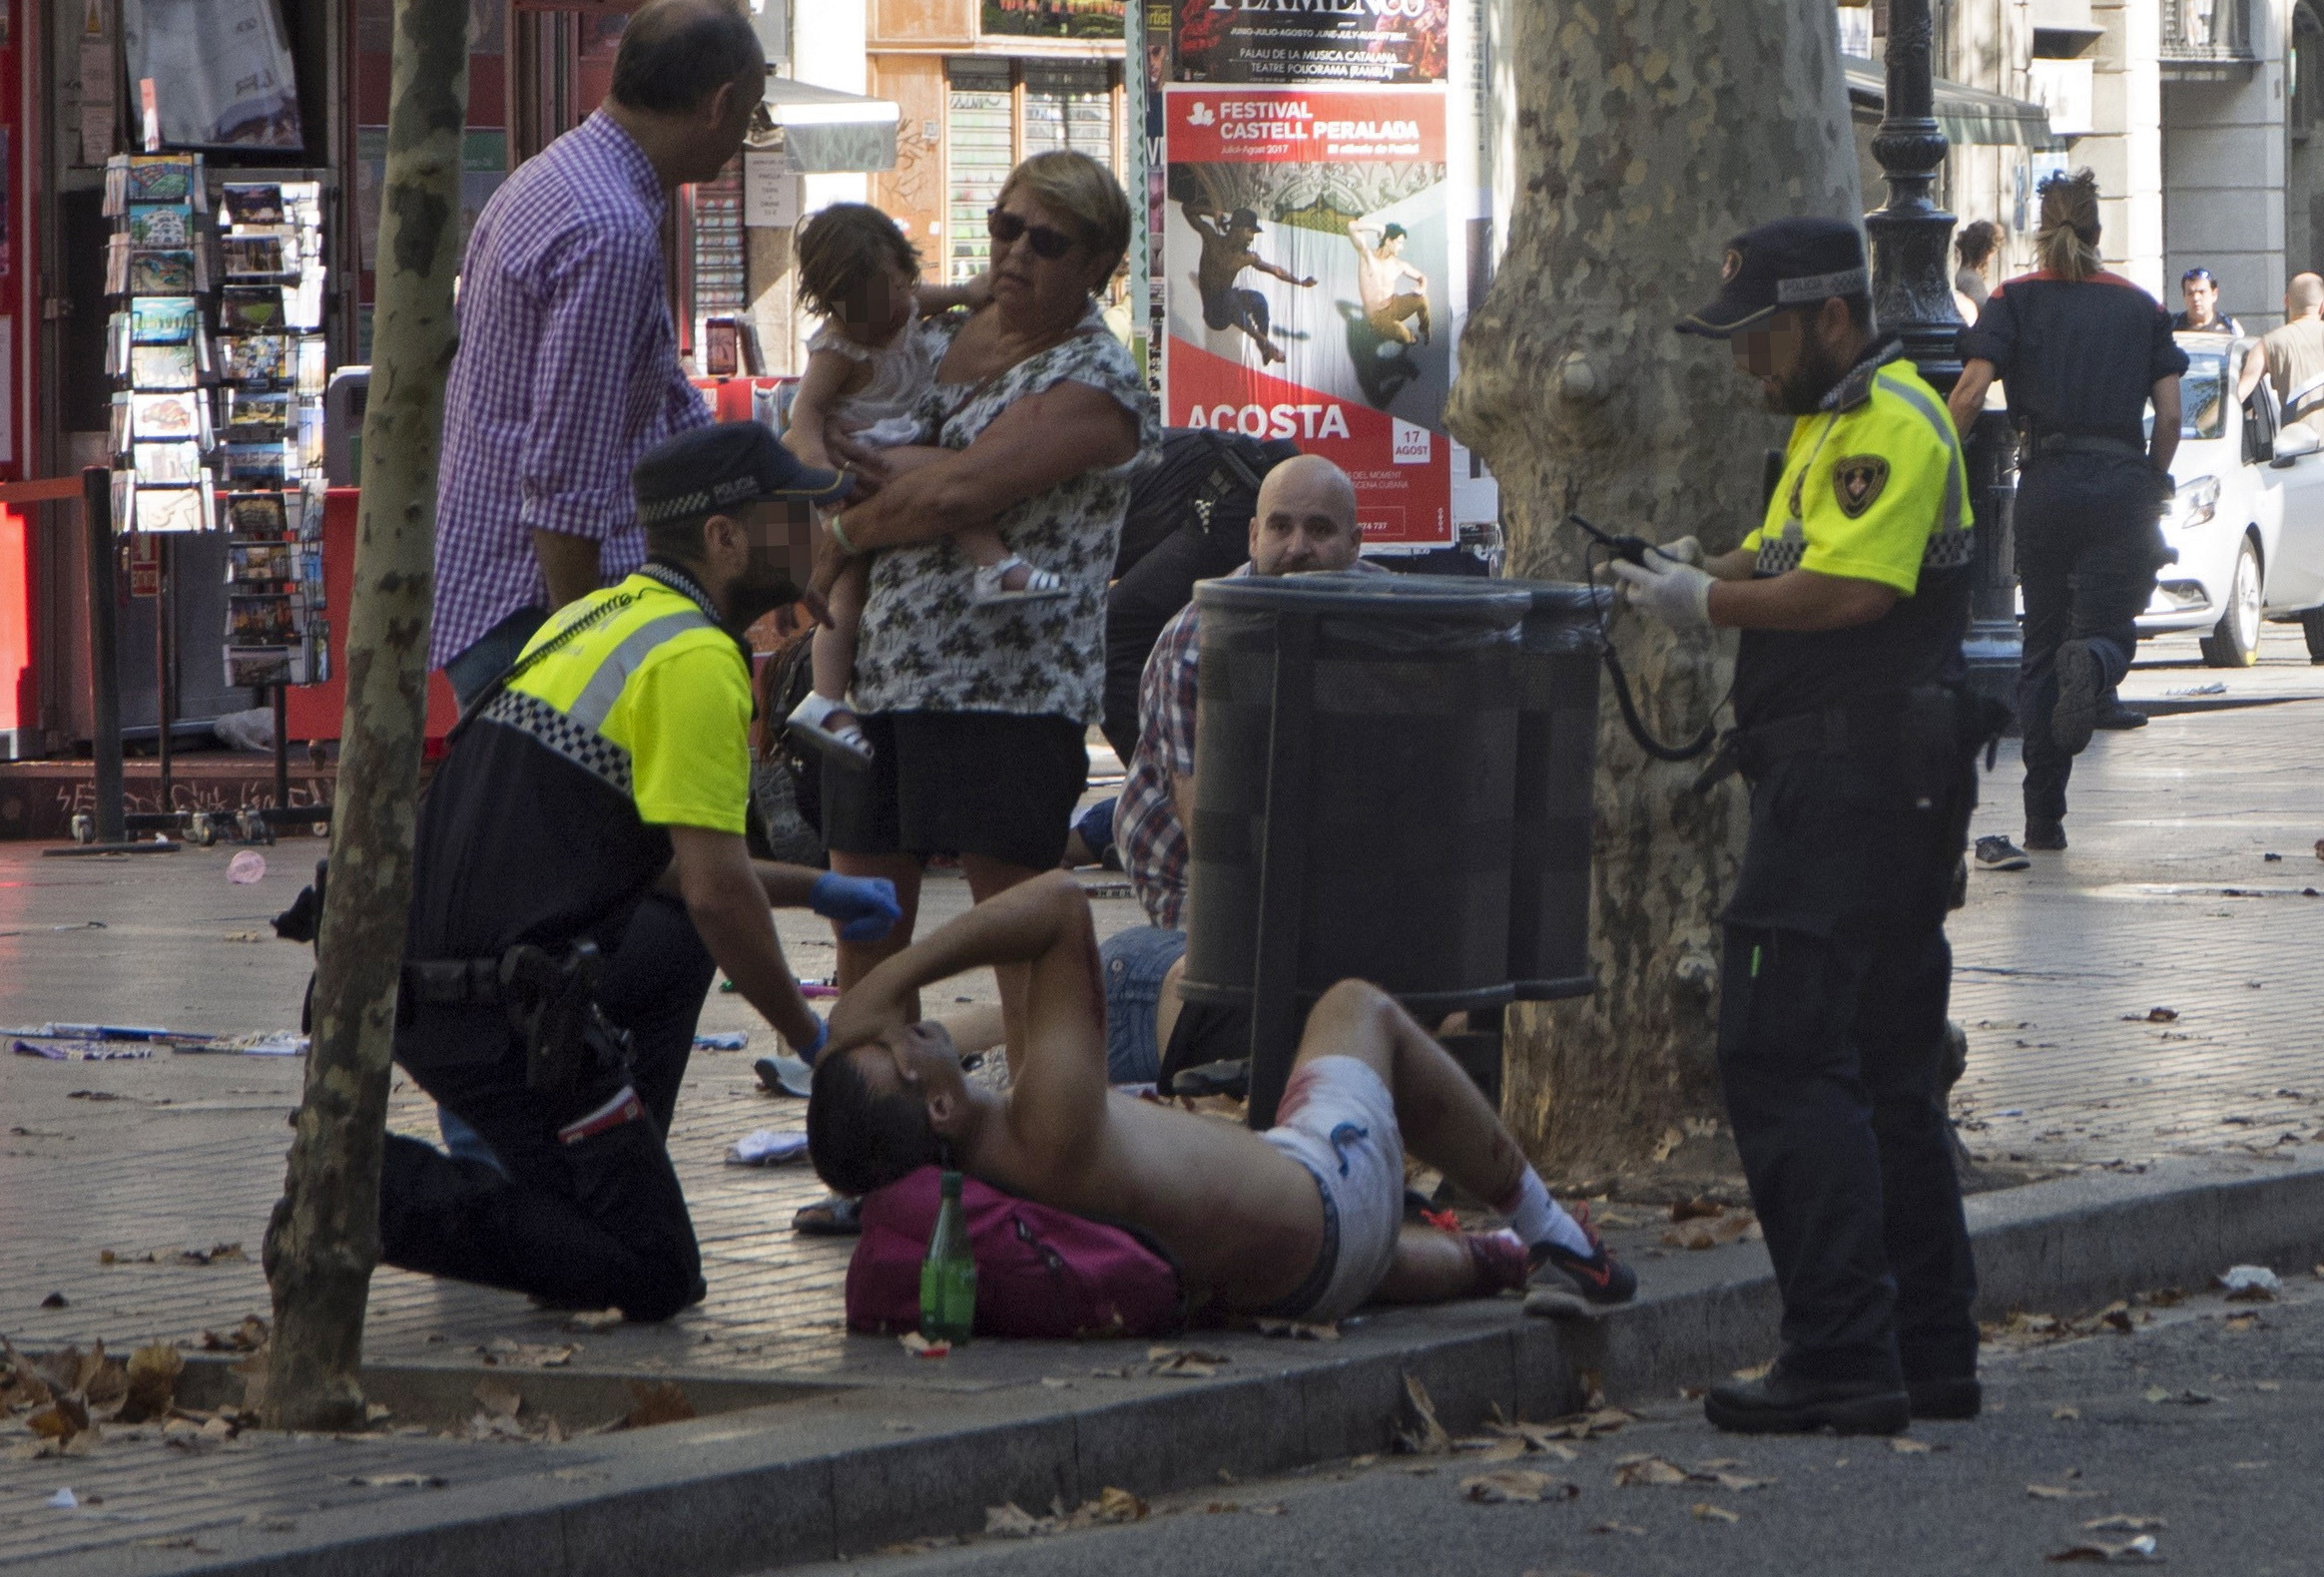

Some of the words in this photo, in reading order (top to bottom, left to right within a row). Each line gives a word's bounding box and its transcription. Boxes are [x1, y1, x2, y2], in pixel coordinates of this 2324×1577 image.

[1240, 48, 1270, 59] PALAU
[1273, 49, 1286, 60] DE
[1289, 50, 1300, 60] LA
[1345, 51, 1398, 63] CATALANA
[1252, 63, 1285, 73] TEATRE
[1288, 63, 1348, 76] POLIORAMA
[1220, 102, 1314, 119] FESTIVAL
[1220, 122, 1308, 140] CASTELL
[1313, 121, 1420, 140] PERALADA
[1266, 143, 1289, 154] 2017
[1188, 404, 1350, 439] ACOSTA
[1404, 430, 1421, 444] 17
[1396, 445, 1429, 456] AGOST
[1354, 470, 1369, 480] DEL
[1370, 470, 1402, 480] MOMENT
[1353, 480, 1378, 490] SCENA
[1379, 480, 1409, 490] CUBANA
